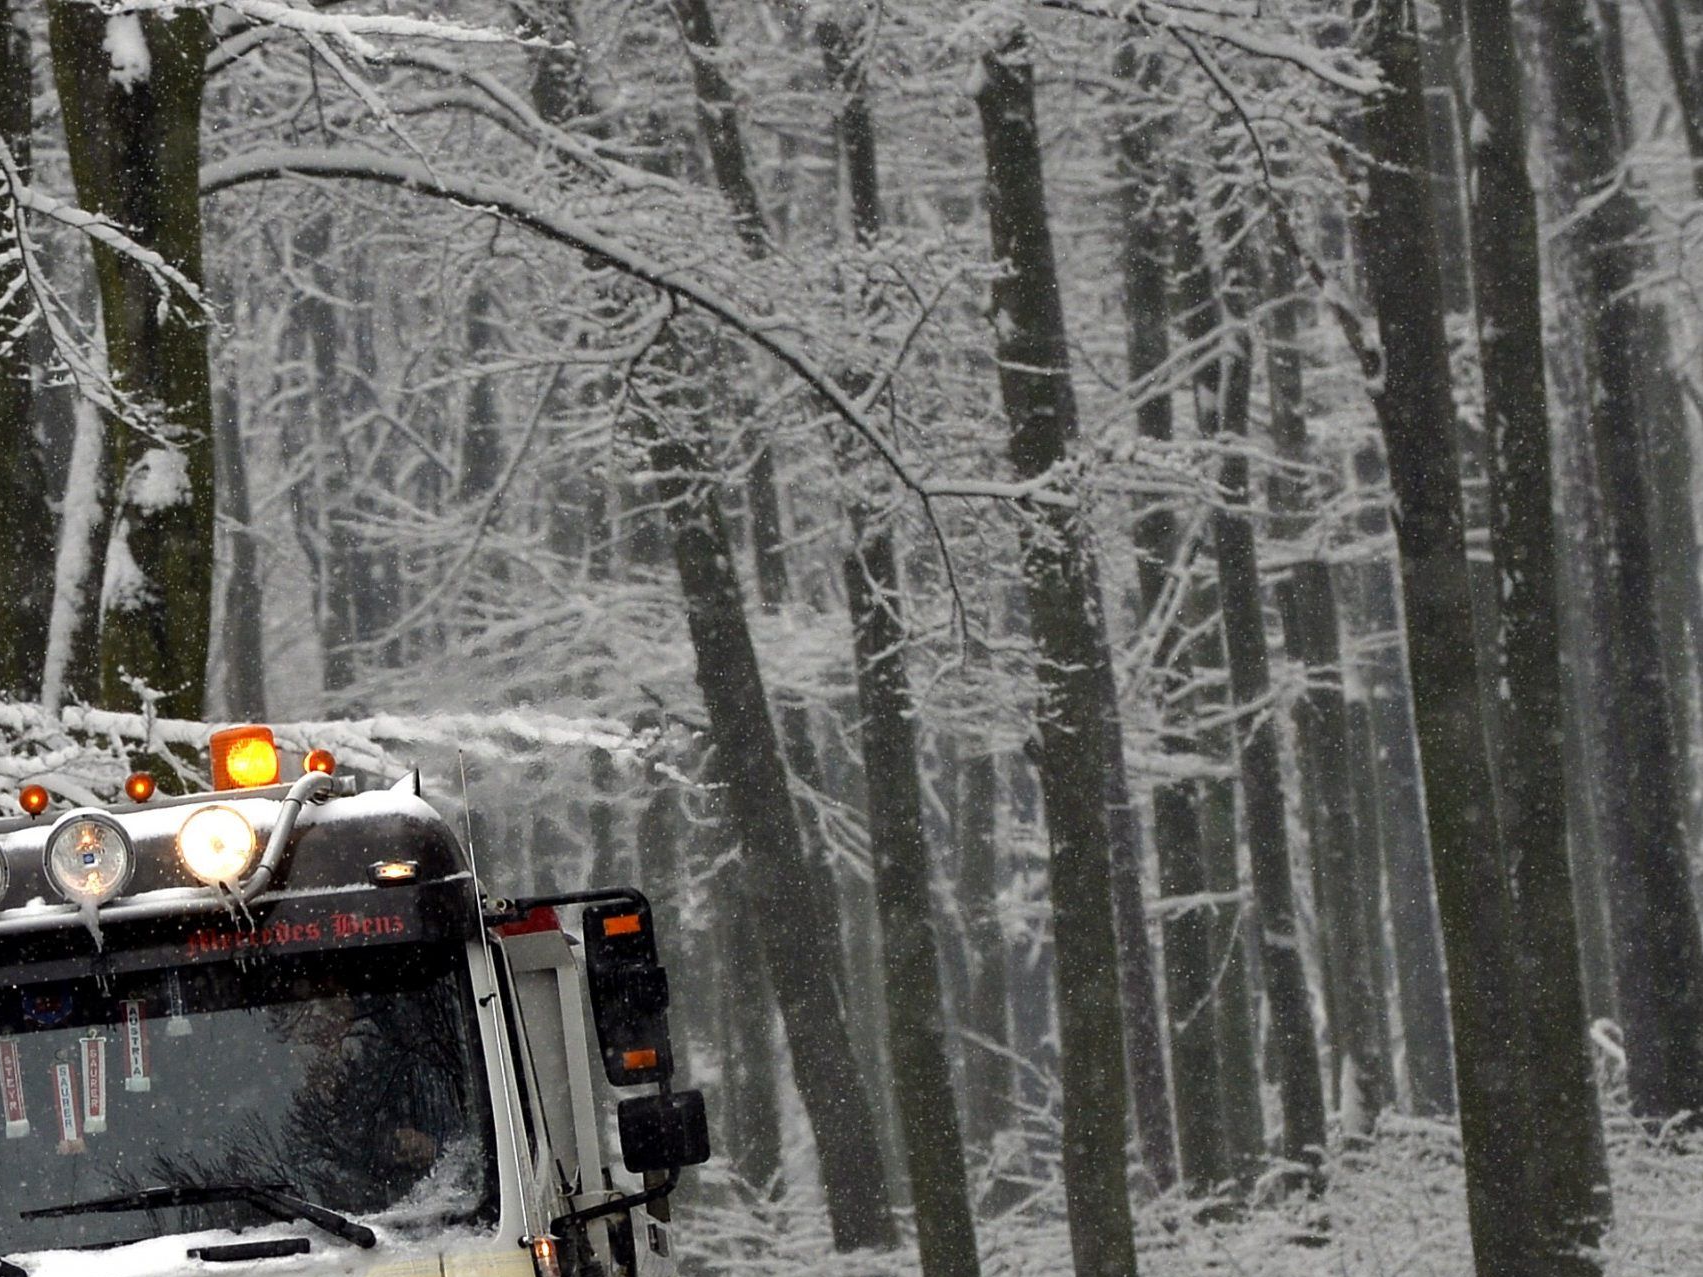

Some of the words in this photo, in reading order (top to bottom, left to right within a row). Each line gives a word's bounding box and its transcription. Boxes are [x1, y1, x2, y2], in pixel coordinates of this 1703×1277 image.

[185, 918, 321, 957] Mercedes
[330, 912, 405, 938] Benz
[129, 1007, 143, 1076] AUSTRIA
[3, 1055, 18, 1111] STEYR
[59, 1067, 73, 1127] SAURER
[89, 1049, 100, 1108] SAURER
